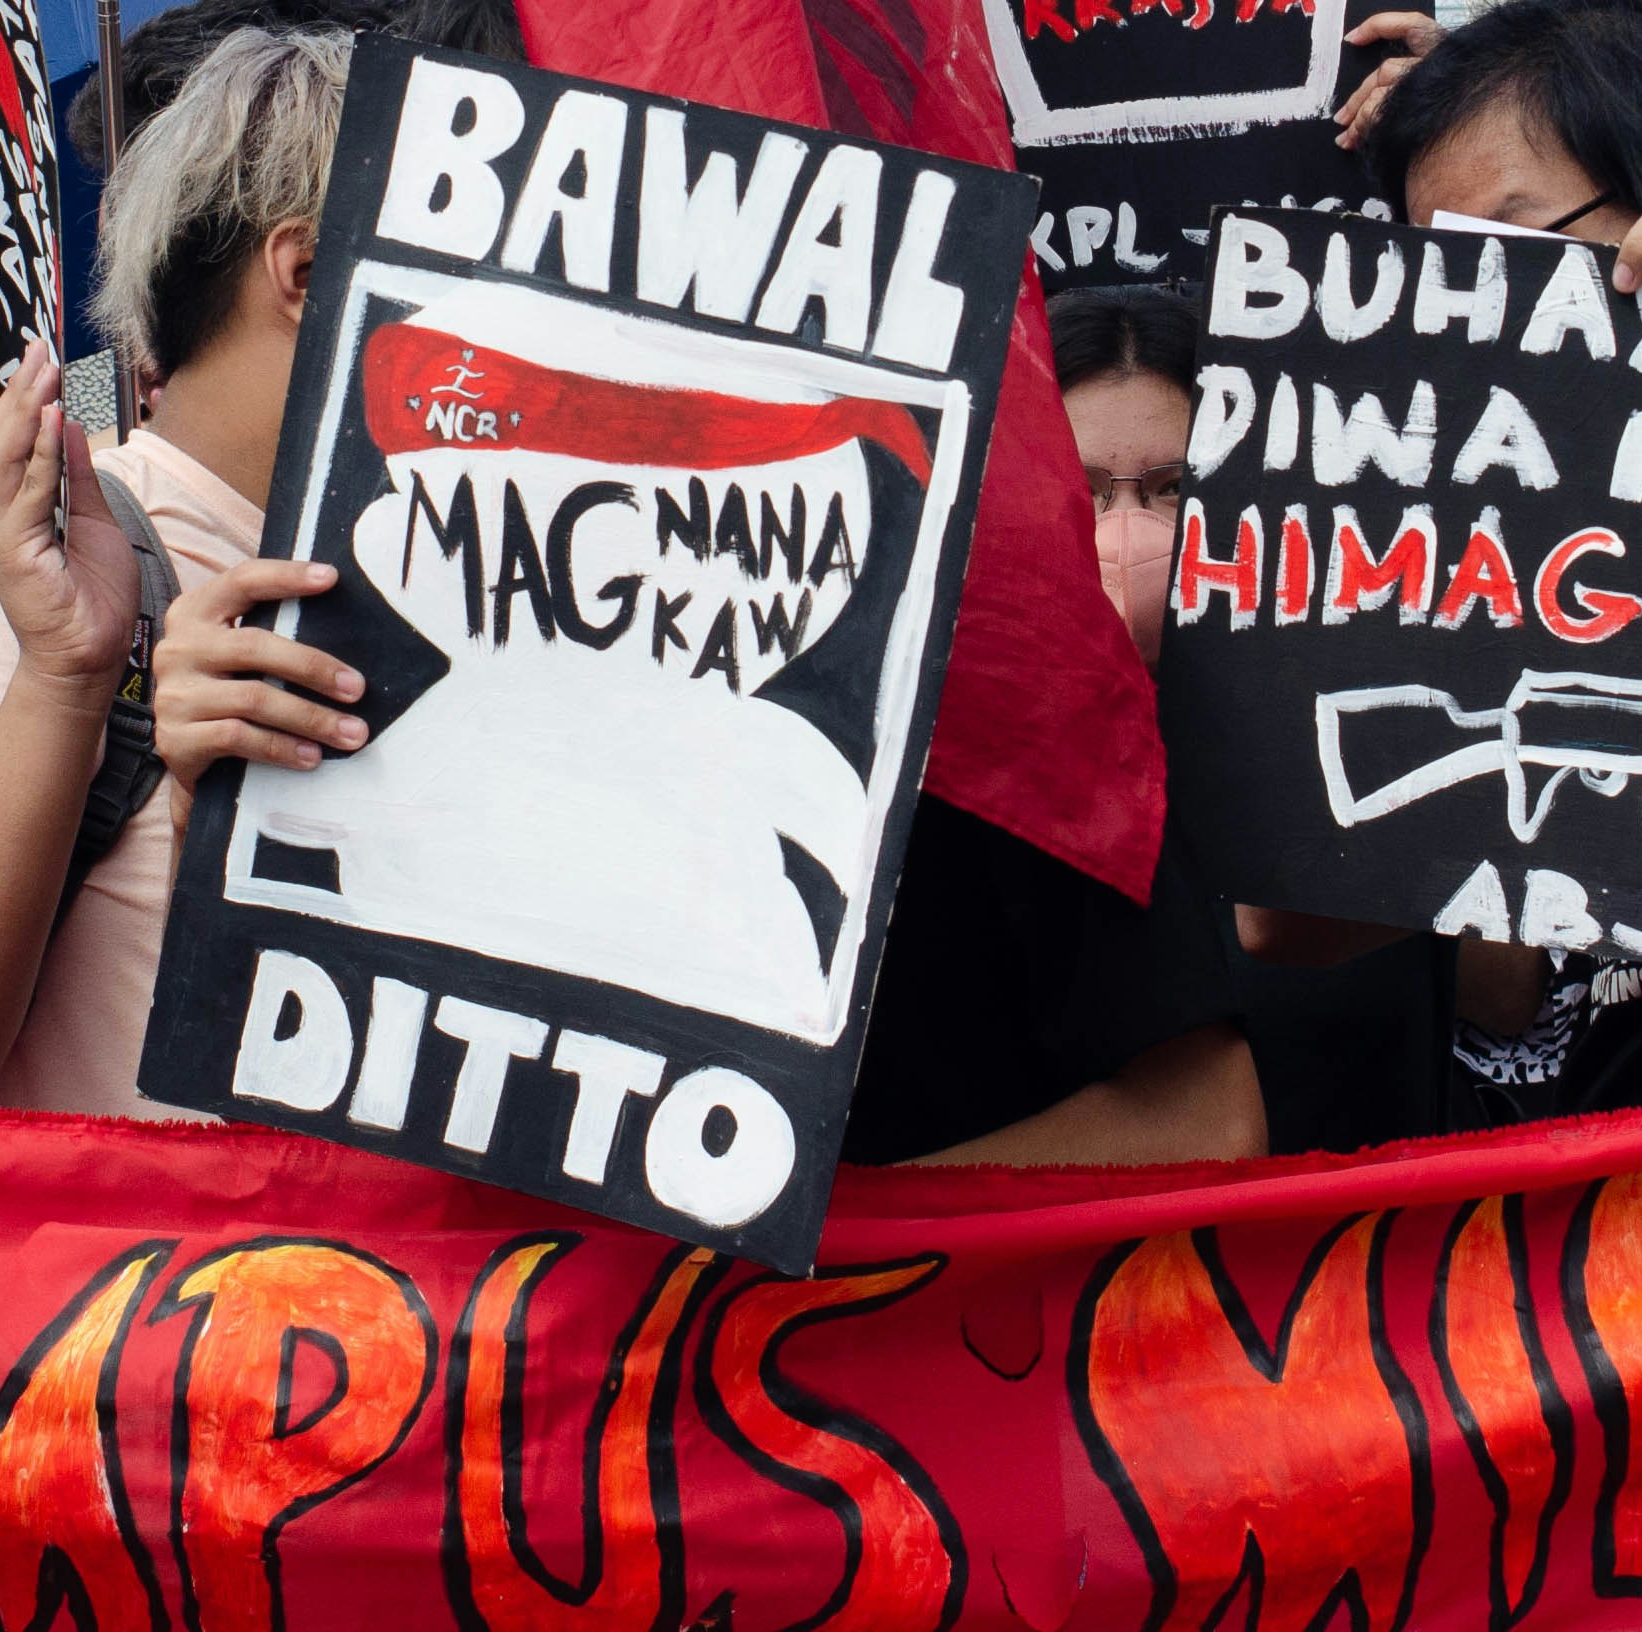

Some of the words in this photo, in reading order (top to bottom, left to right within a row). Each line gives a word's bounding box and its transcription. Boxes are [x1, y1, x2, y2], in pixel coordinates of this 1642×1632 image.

[376, 55, 965, 371] BAWAL
[425, 400, 499, 443] NCR
[1186, 362, 1560, 488] DIWA
[399, 466, 650, 651] MAG
[655, 474, 859, 586] NANA
[653, 586, 817, 698] KAW
[232, 948, 796, 1230] DITTO
